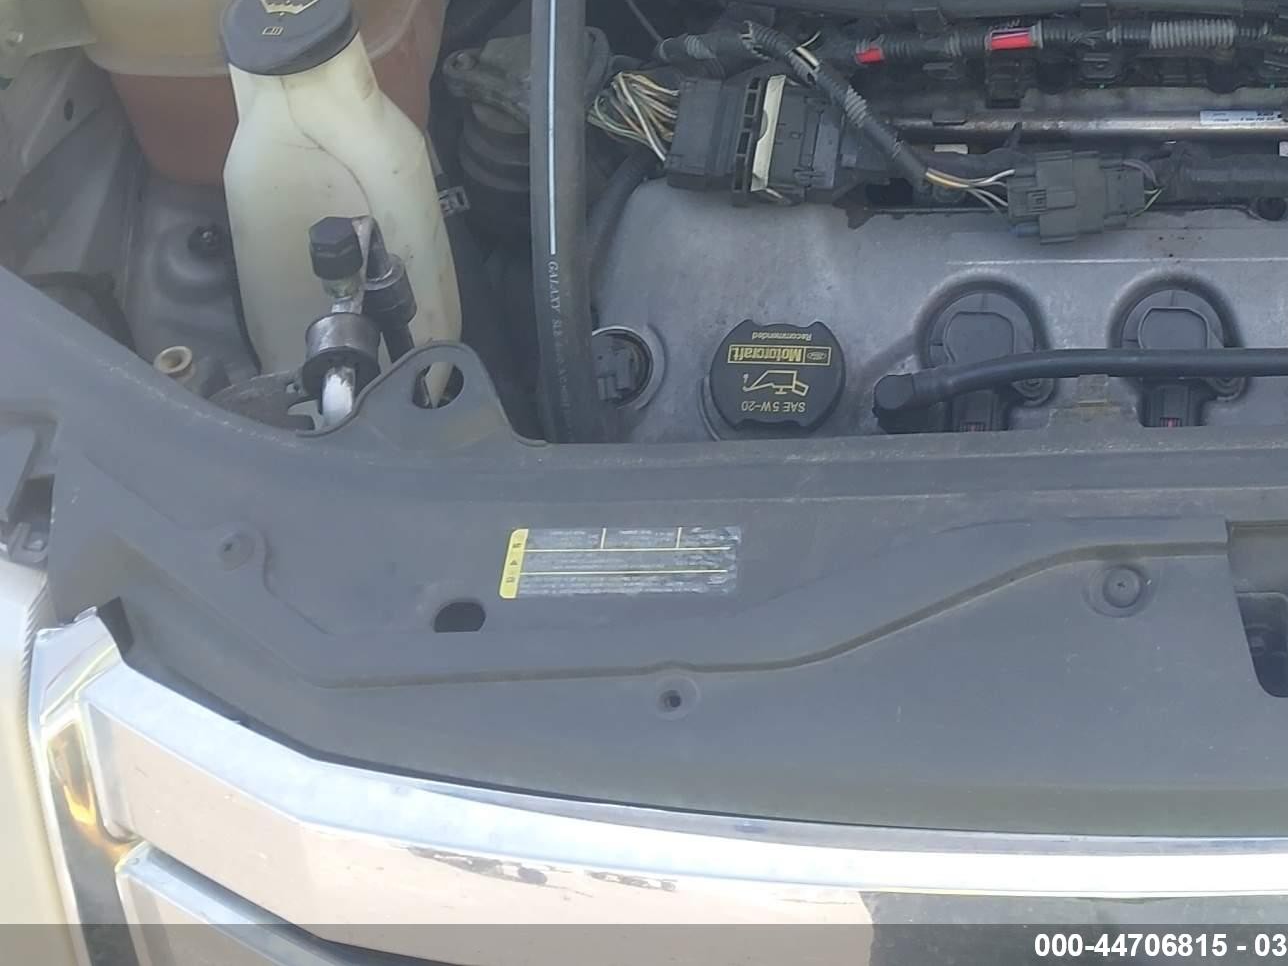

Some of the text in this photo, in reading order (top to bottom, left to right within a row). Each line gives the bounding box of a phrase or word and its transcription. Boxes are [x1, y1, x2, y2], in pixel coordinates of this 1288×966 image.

[548, 261, 560, 313] GALAXY
[751, 331, 813, 342] Recommended
[731, 347, 803, 363] Motorcraft
[783, 401, 806, 413] SAE
